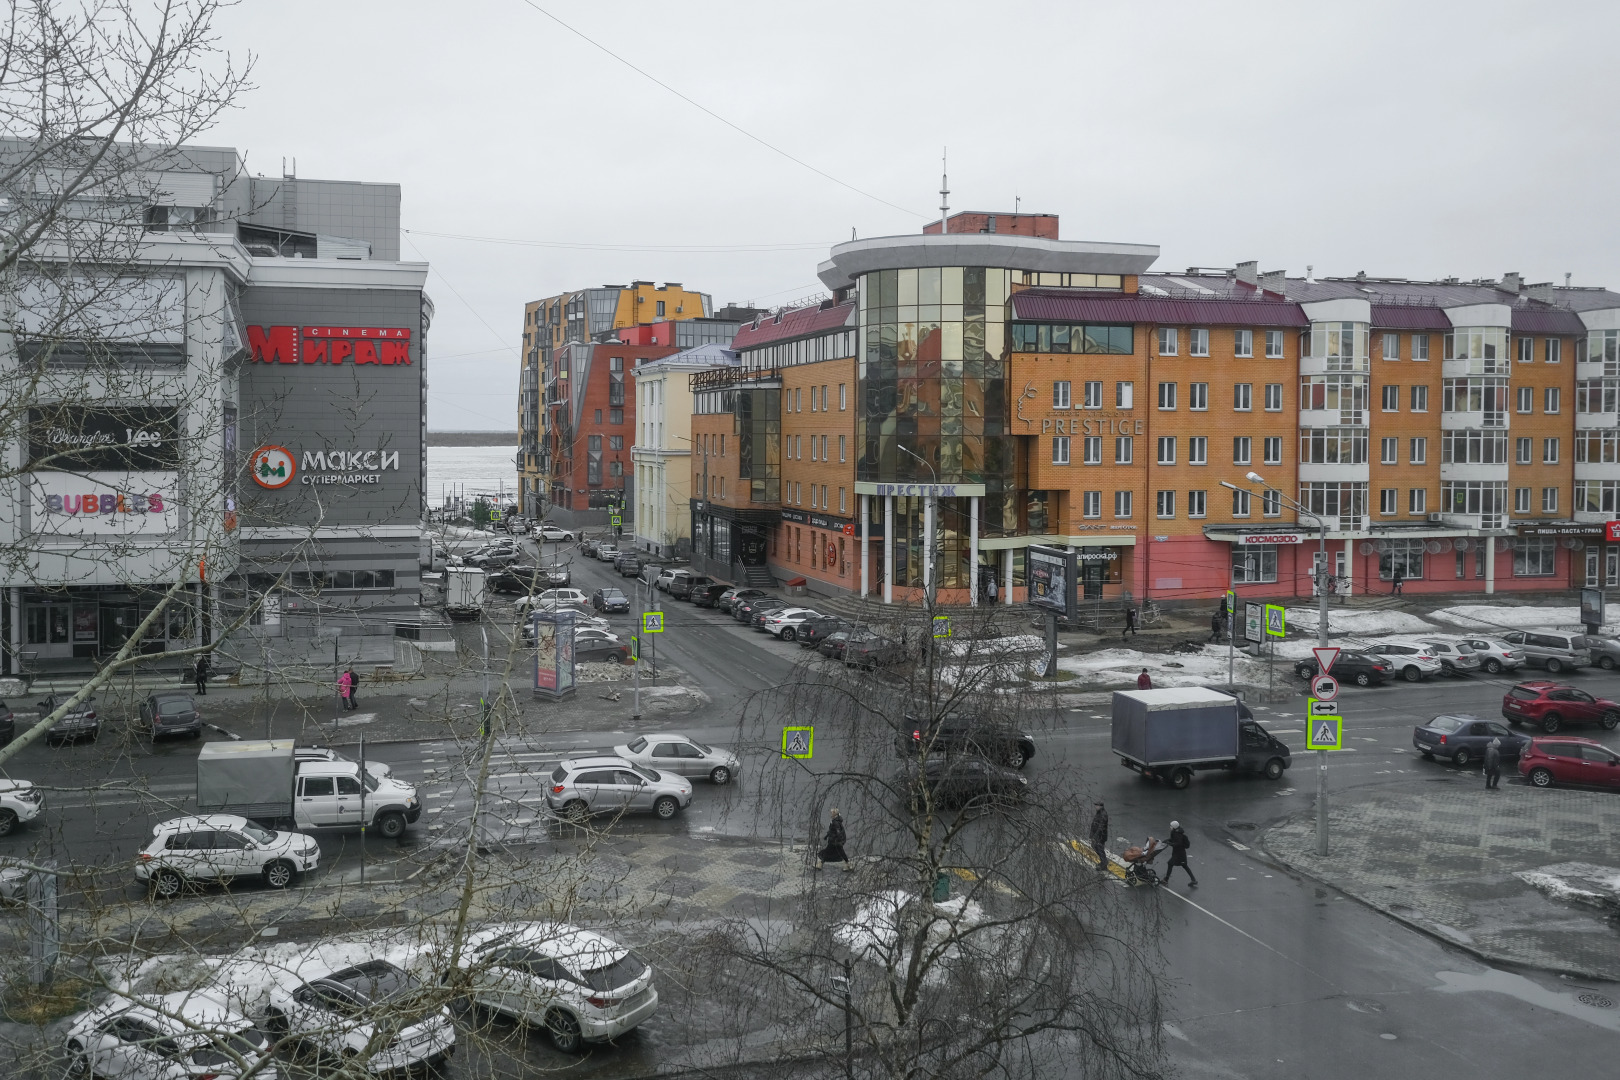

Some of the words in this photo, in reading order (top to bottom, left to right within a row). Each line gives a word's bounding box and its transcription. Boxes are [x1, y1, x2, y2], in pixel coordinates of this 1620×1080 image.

[311, 328, 403, 337] CINEMA
[1042, 419, 1144, 435] PRESTIGE
[301, 474, 381, 485] СУПЕРМАРКЕТ
[876, 484, 957, 497] ПРЕСТИЖ
[46, 493, 164, 513] BUBBLES
[1245, 535, 1298, 544] КОСМОЗОО
